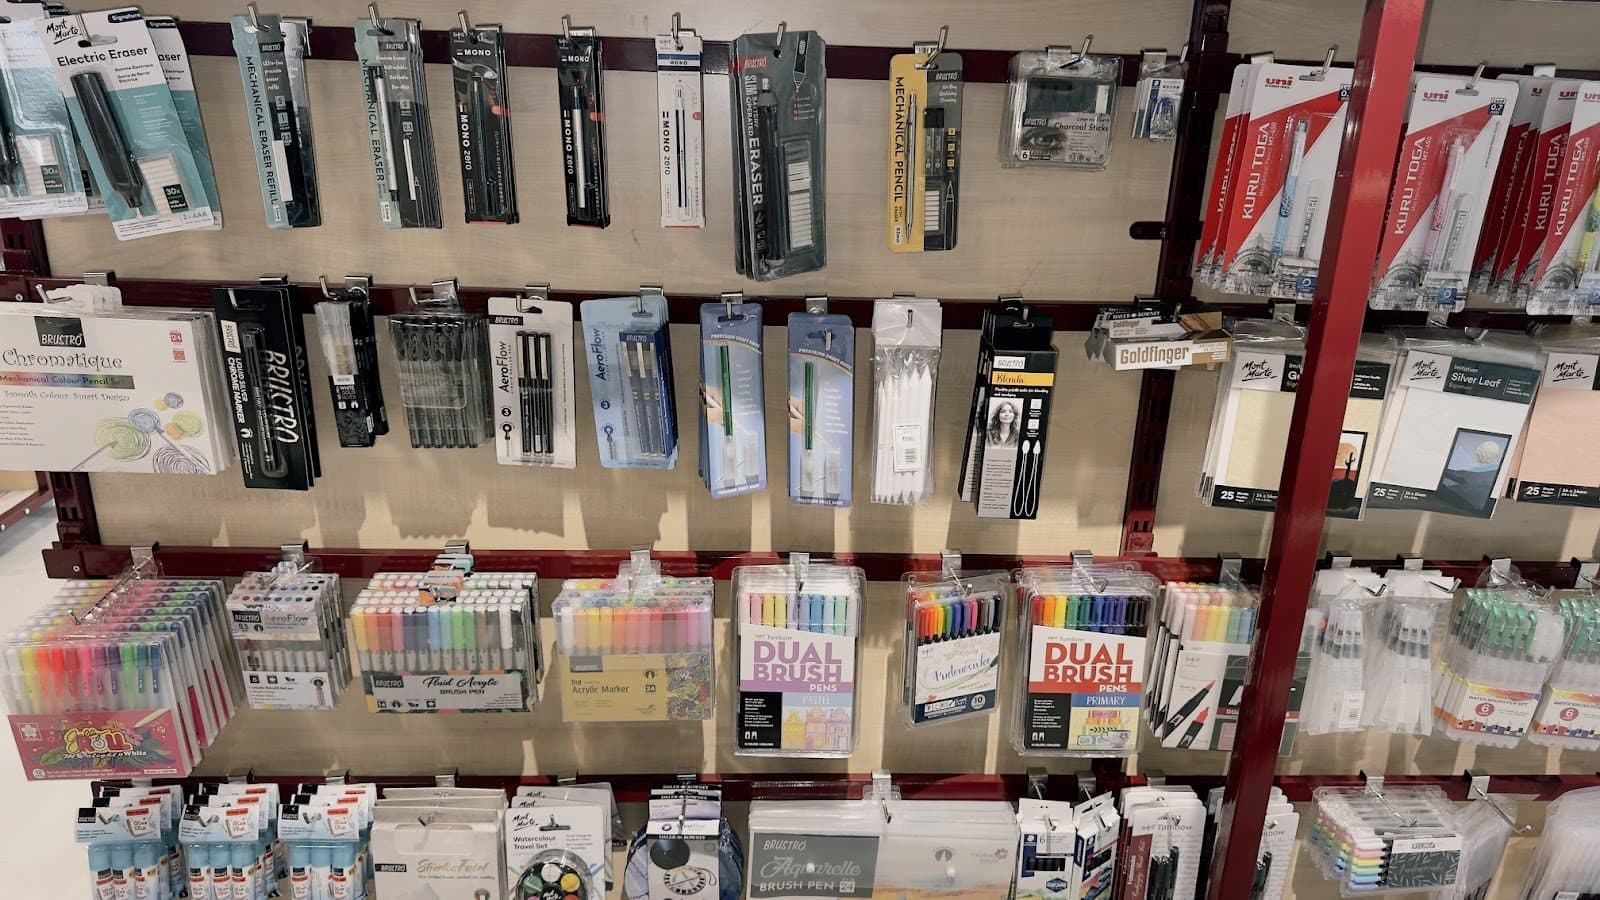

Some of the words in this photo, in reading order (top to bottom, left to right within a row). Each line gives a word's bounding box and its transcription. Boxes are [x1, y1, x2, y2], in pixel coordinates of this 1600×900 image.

[46, 18, 68, 34] Mont
[54, 27, 81, 41] Marte
[56, 52, 106, 68] Electric
[109, 47, 148, 64] Eraser
[158, 54, 181, 62] aser
[1266, 76, 1294, 86] uni
[1423, 90, 1449, 100] uni
[896, 76, 904, 157] MECHANICAL
[246, 56, 262, 126] MECHANICAL
[259, 130, 272, 169] ERASER
[266, 171, 278, 205] REFILL
[461, 114, 470, 148] MONO
[1054, 122, 1087, 132] Charcoal
[1089, 123, 1109, 132] Sticks
[564, 119, 572, 152] MONO
[372, 139, 385, 182] ERASER
[464, 149, 472, 171] zero
[1022, 152, 1028, 160] 6
[750, 138, 764, 206] ERASER
[1242, 173, 1261, 220] KURU
[1252, 122, 1270, 172] TOGA
[894, 161, 904, 203] PENCIL
[1394, 188, 1414, 234] KURU
[1406, 137, 1426, 182] TOGA
[1535, 184, 1552, 230] KURU
[1544, 134, 1562, 181] TOGA
[1554, 188, 1572, 236] KURU
[1566, 138, 1584, 186] TOGA
[166, 187, 182, 196] 30x
[41, 334, 84, 346] BRUSTRO
[2, 349, 122, 372] Chromatique
[590, 328, 606, 381] AeroFlow
[1120, 346, 1190, 364] Goldfinger
[496, 341, 510, 393] AeroFlow
[1242, 360, 1266, 370] Mont
[1412, 360, 1436, 370] Mont
[1554, 360, 1578, 370] Mont
[0, 376, 49, 384] Mechanical
[52, 376, 80, 385] Colour
[82, 376, 108, 386] Pencil
[236, 358, 244, 379] LIQUID
[240, 380, 248, 402] SILVER
[1451, 372, 1478, 386] Silver
[1479, 376, 1502, 388] Leaf
[228, 357, 240, 390] CHROME
[234, 390, 246, 424] MARKER
[1220, 490, 1235, 500] 25
[1374, 488, 1387, 497] 25
[1526, 486, 1540, 496] 25
[264, 614, 308, 622] AeroFlow
[754, 641, 842, 664] DUAL
[1045, 642, 1133, 665] DUAL
[754, 664, 842, 682] BRUSH
[1044, 666, 1133, 684] BRUSH
[423, 676, 454, 688] Fluid
[456, 676, 499, 689] Acrylic
[572, 686, 598, 694] Acrylic
[602, 686, 629, 694] Marker
[810, 684, 838, 692] PENS
[1099, 684, 1127, 692] PENS
[1086, 696, 1126, 706] PRIMARY
[1482, 705, 1489, 713] 6
[1566, 710, 1573, 718] 6
[763, 840, 806, 851] BRUSTRO
[760, 882, 803, 892] BRUSH
[808, 881, 834, 890] PEN
